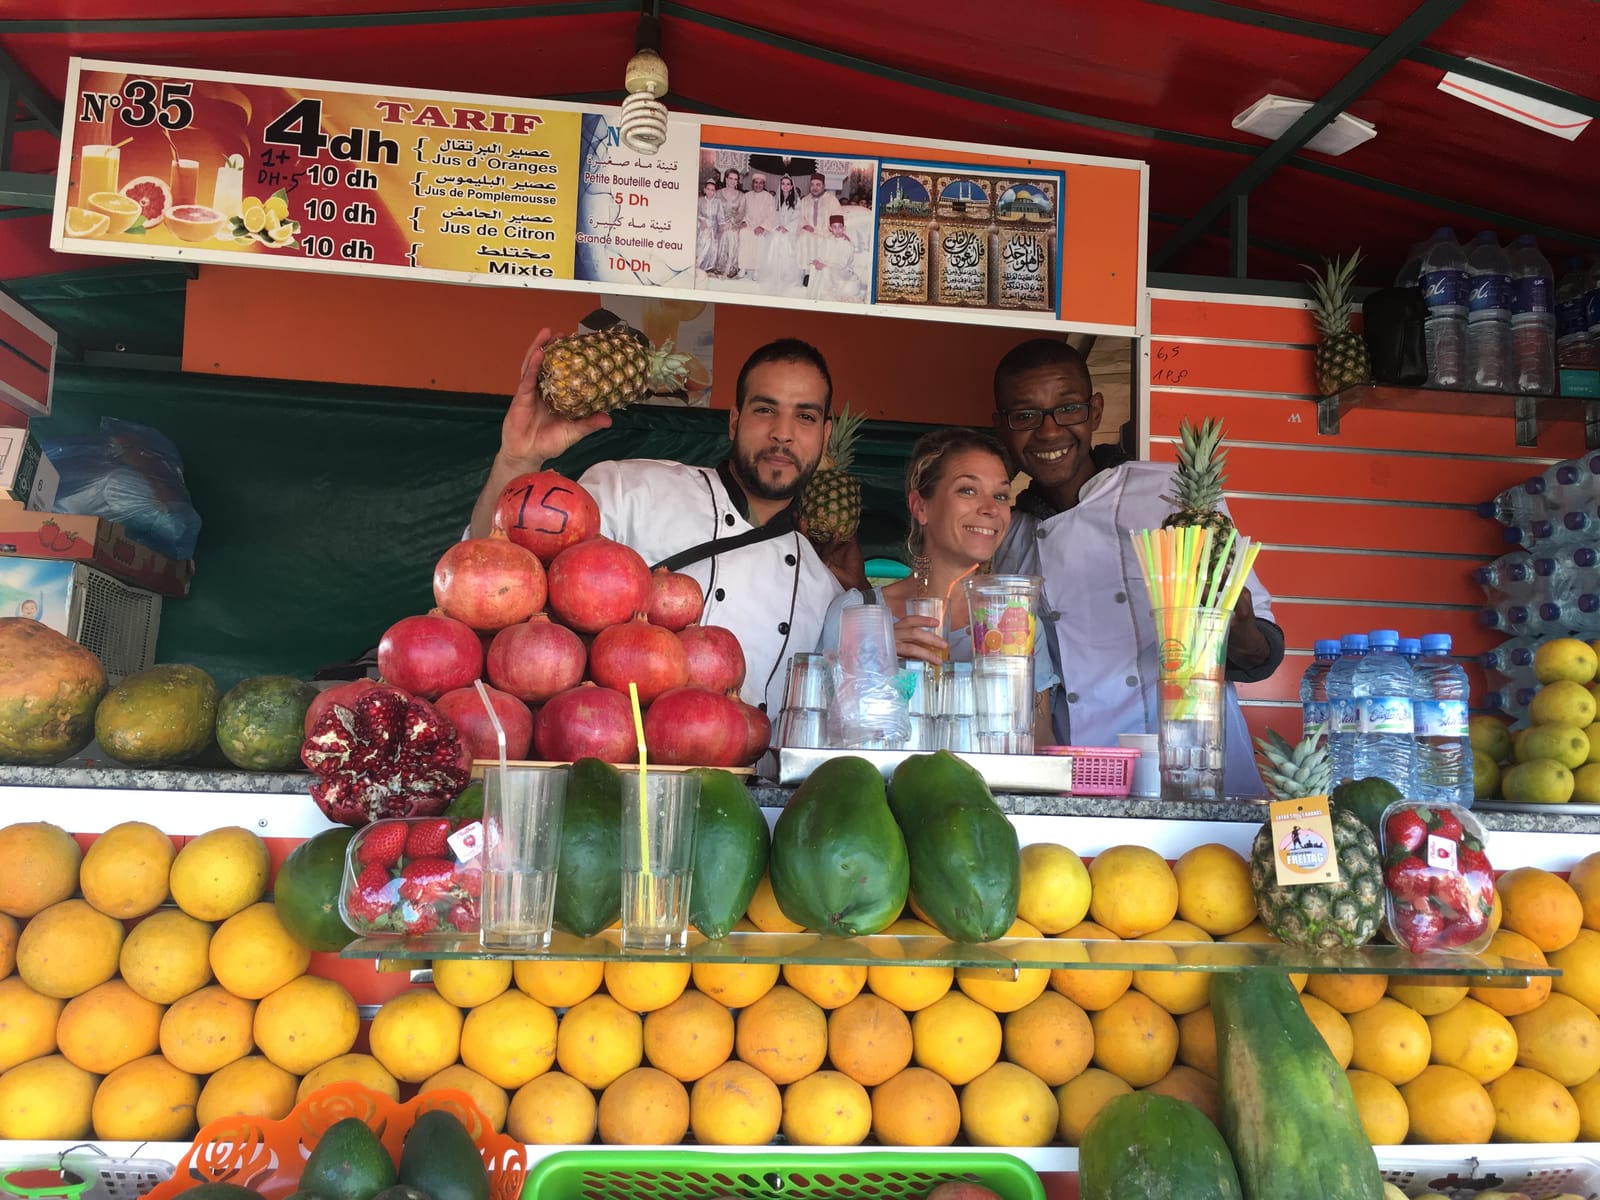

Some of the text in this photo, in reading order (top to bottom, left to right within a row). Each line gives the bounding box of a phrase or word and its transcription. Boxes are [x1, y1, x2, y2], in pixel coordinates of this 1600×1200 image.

[376, 101, 544, 135] TARIF
[439, 138, 551, 159] عصير البرتقال
[432, 153, 461, 166] Jus
[586, 154, 630, 168] صغيرة
[634, 158, 653, 169] ماء
[307, 164, 379, 190] 10 dh
[584, 172, 680, 190] Petite Bouteille d'eau
[511, 181, 557, 191] عصير
[424, 185, 557, 205] Jus de Pomplemousse
[615, 192, 649, 207] 5 Dh
[304, 198, 377, 225] 10 dh
[441, 206, 553, 224] عصير الحامض
[440, 221, 556, 242] Jus de Citron
[588, 216, 624, 230] كبيرة
[628, 218, 646, 229] ماء
[302, 235, 375, 261] 10 dh
[576, 232, 684, 251] Grande Bouteille d'eau
[476, 245, 551, 260] مختلط
[488, 261, 554, 278] Mixte
[608, 257, 651, 273] 10 Dh
[507, 484, 574, 535] 15
[1286, 852, 1324, 865] FREITAG
